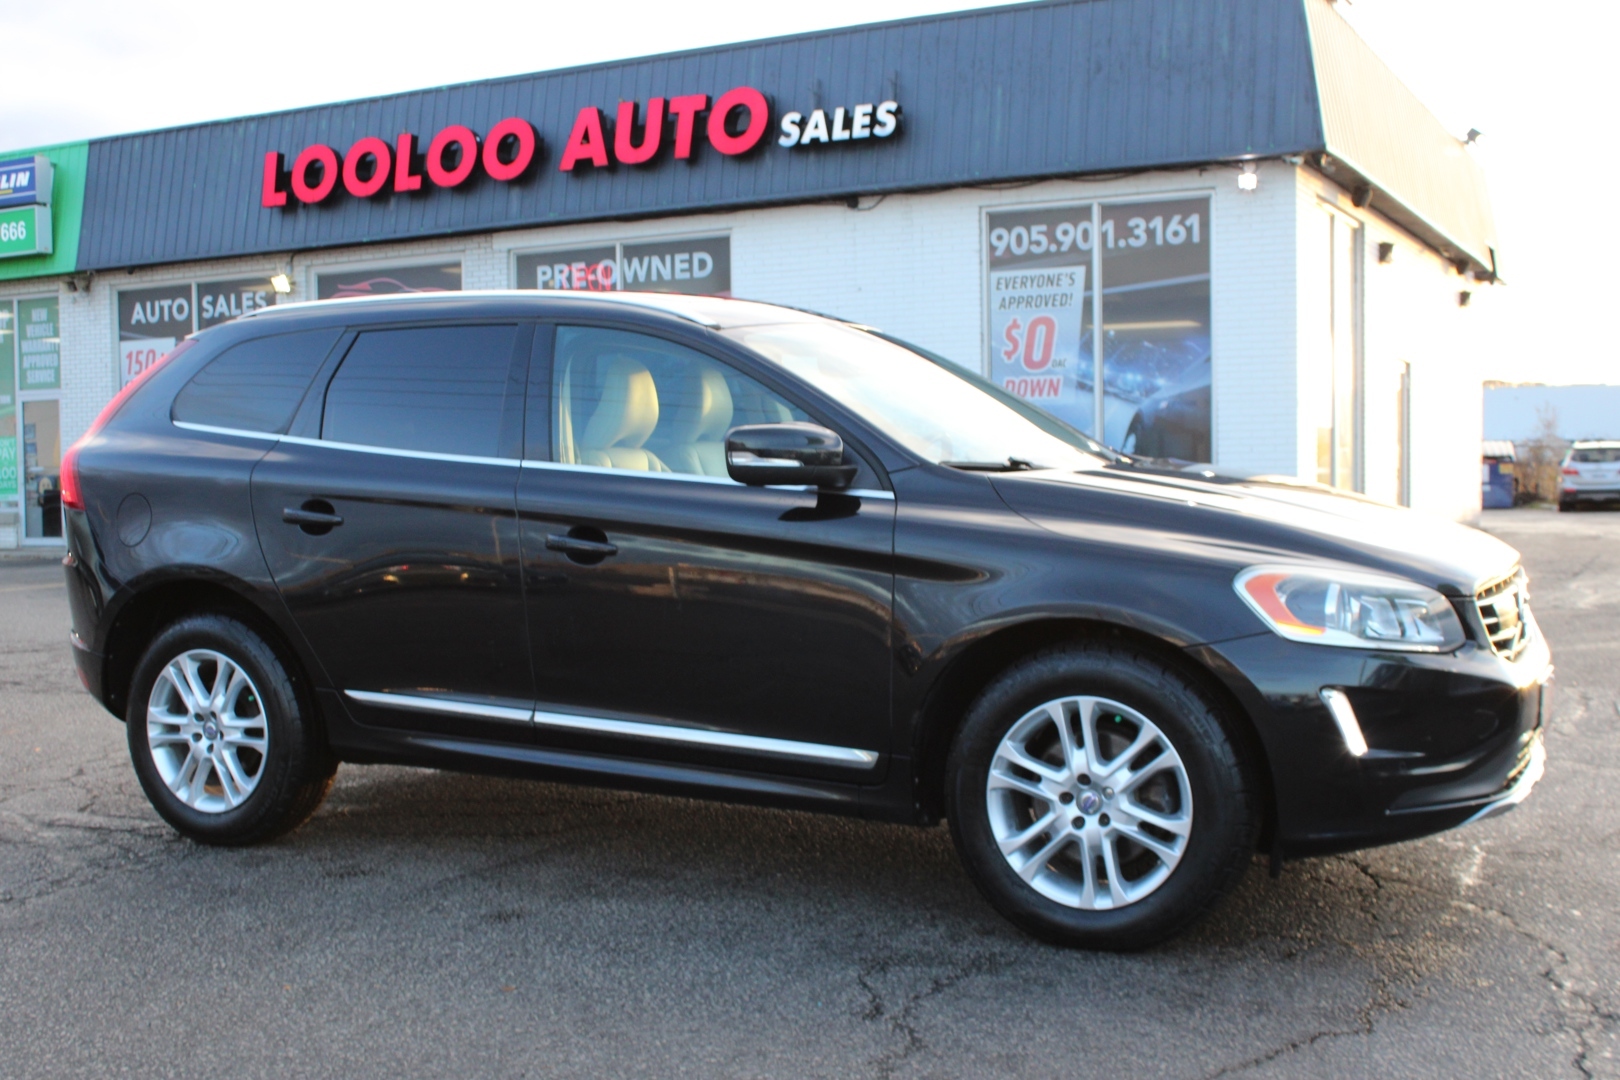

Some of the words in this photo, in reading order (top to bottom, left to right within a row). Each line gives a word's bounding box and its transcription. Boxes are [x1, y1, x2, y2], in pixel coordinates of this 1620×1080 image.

[262, 117, 535, 208] LOOLOO
[559, 86, 768, 172] AUTO
[778, 100, 898, 147] SALES
[990, 213, 1200, 257] 905.901.3161
[536, 251, 713, 290] PRE-OWNED
[996, 271, 1076, 291] EVERYONE'S
[131, 297, 189, 325] AUTO
[201, 291, 267, 319] SALES
[999, 293, 1073, 310] APPROVED!
[1003, 315, 1056, 371] $0
